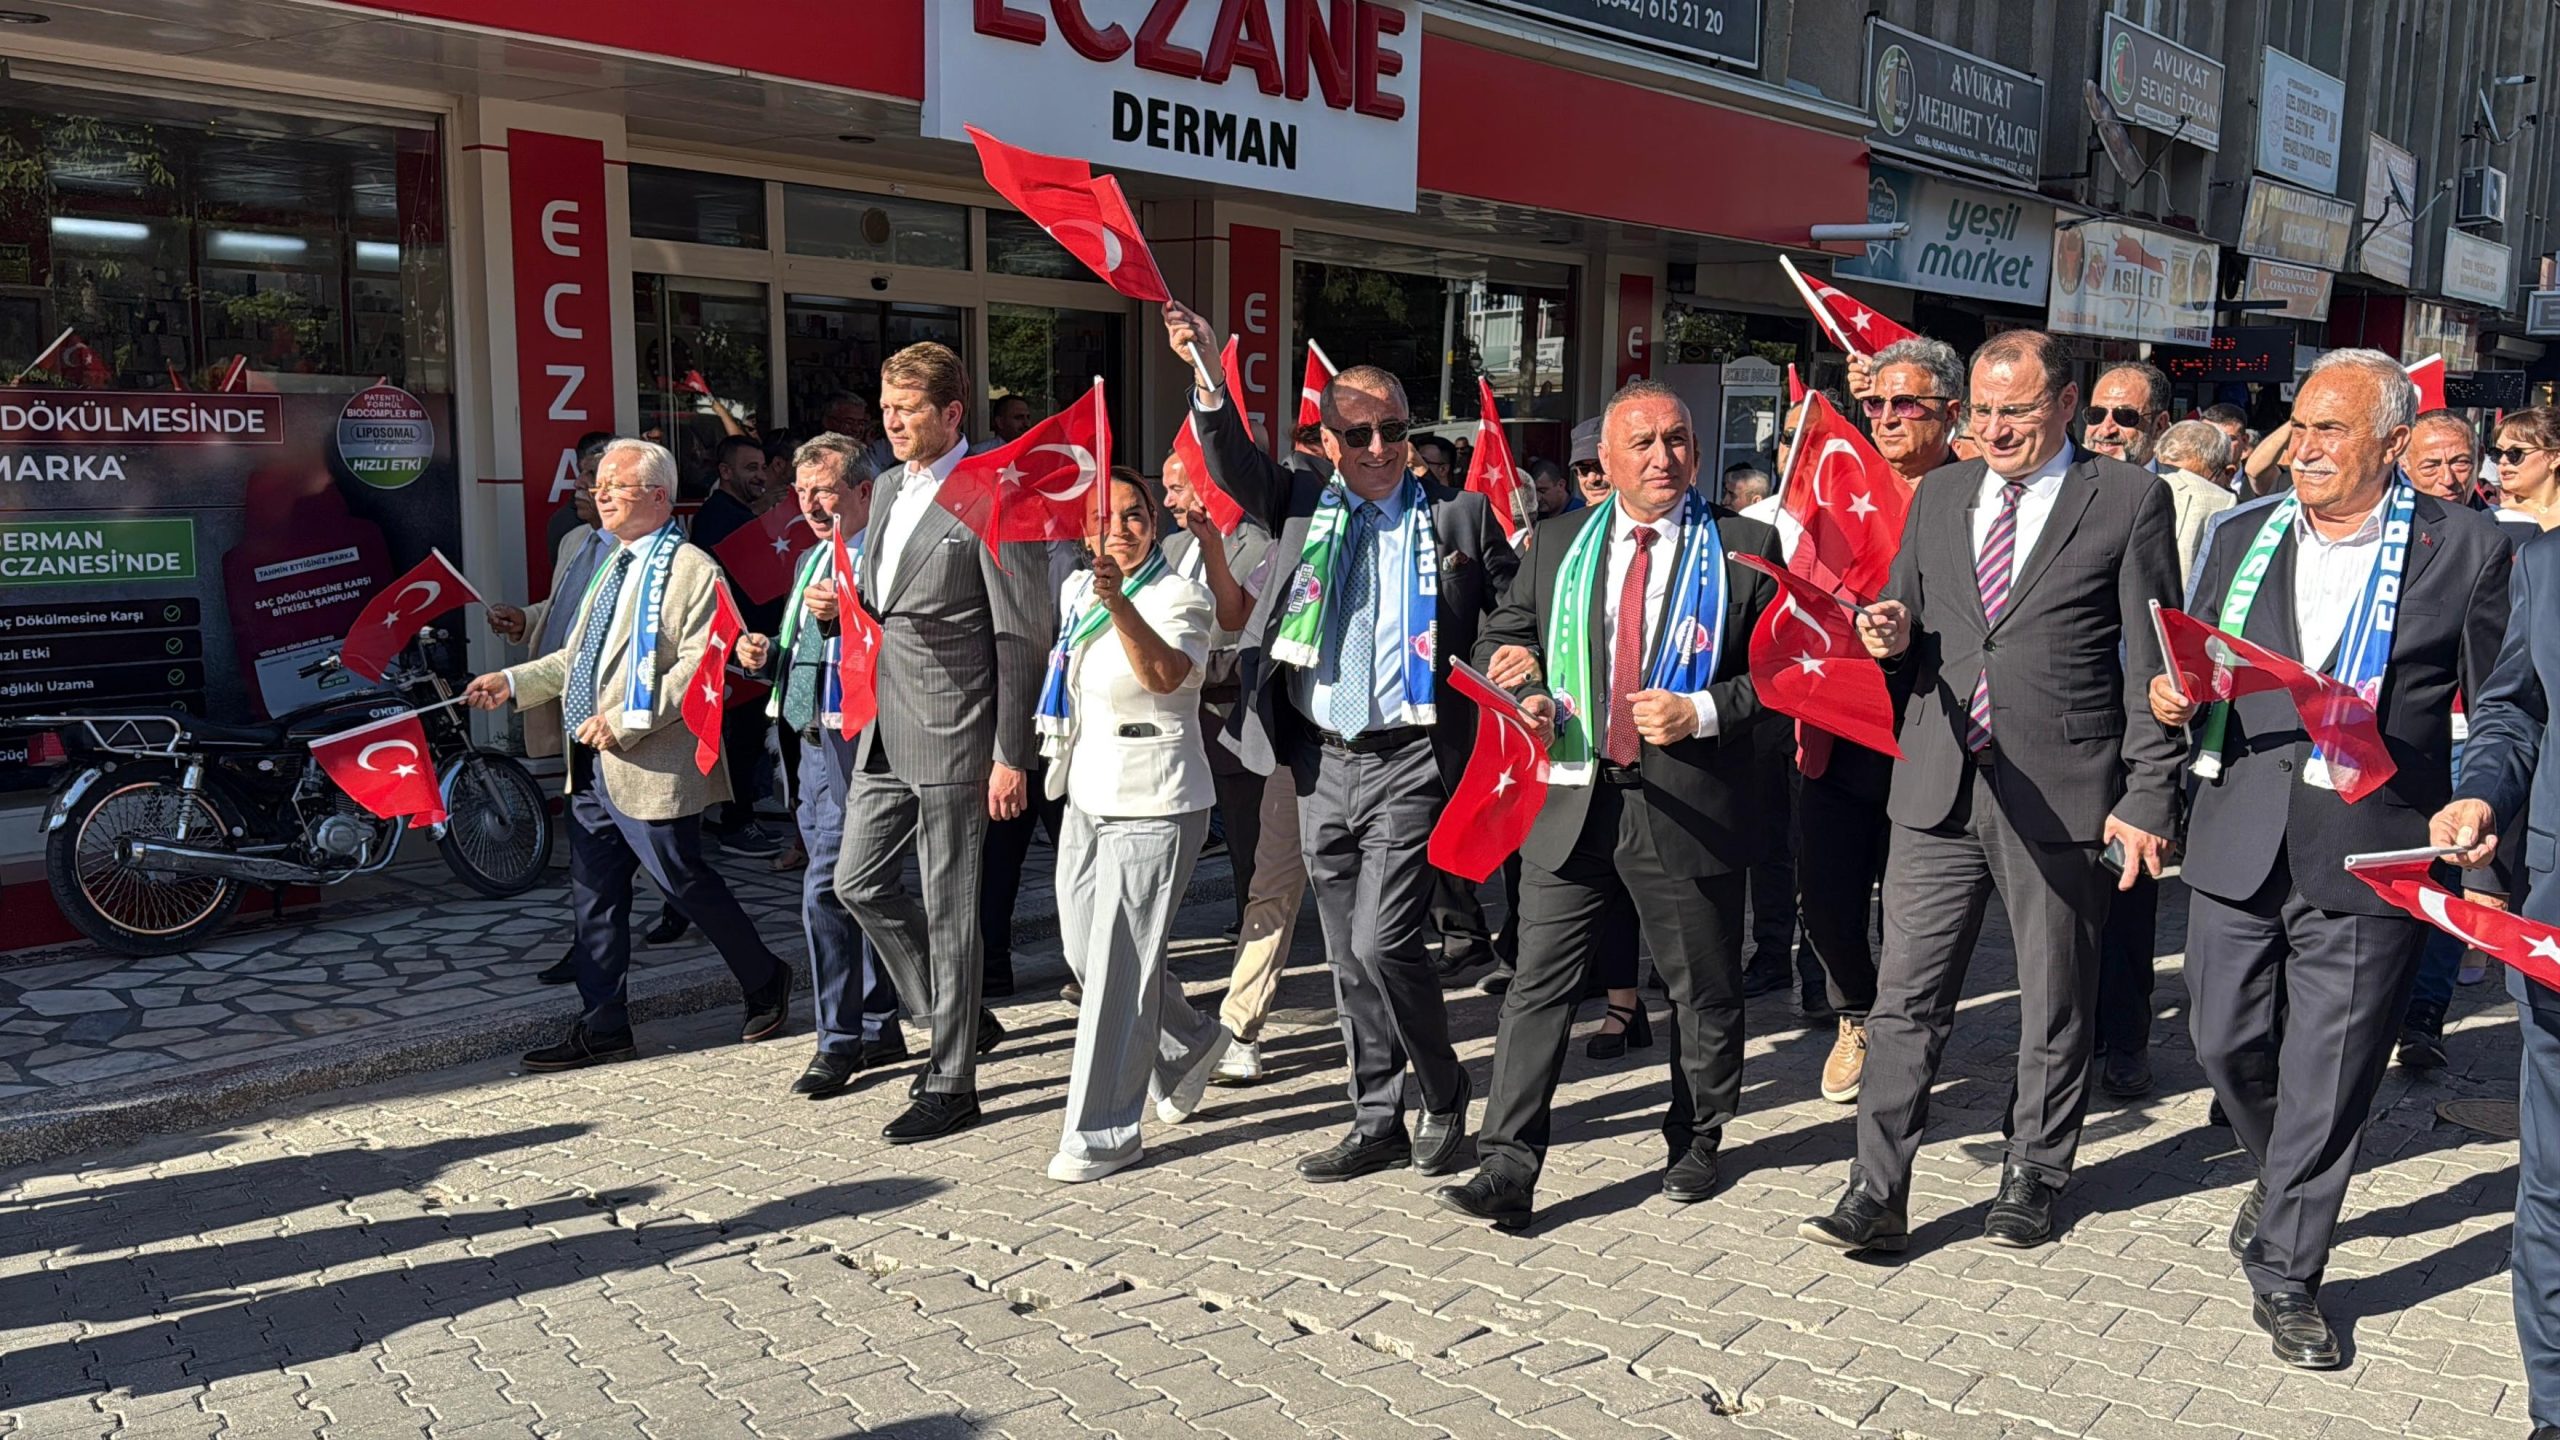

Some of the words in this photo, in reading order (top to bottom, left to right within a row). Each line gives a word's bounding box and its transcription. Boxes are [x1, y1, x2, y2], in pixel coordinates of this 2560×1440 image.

[1649, 0, 1678, 23] 615
[1682, 1, 1699, 29] 21
[1705, 8, 1723, 35] 20
[2153, 49, 2210, 90] AVUKAT
[1950, 64, 2014, 110] AVUKAT
[2140, 76, 2177, 108] SEVGİ
[2180, 86, 2217, 124] ÖZKAN
[1112, 89, 1297, 170] DERMAN
[1916, 93, 1983, 140] MEHMET
[1986, 113, 2038, 159] YALÇIN
[1946, 198, 2022, 245] yeşil
[1917, 242, 2033, 289] market
[2271, 266, 2317, 282] OSMANLI
[2112, 267, 2143, 295] ASİL
[2150, 275, 2164, 298] ET
[2263, 280, 2319, 297] LOKANTASI
[1, 399, 266, 433] DÖKÜLMESİNDE
[356, 427, 416, 439] LIPOSOMAL
[353, 459, 388, 471] HIZLI
[391, 457, 422, 471] ETKİ
[0, 530, 103, 553] ERMAN
[259, 565, 288, 578] TAHMİN
[328, 551, 355, 563] MARKA
[2376, 520, 2409, 631] EBER
[255, 597, 275, 610] SAÇ
[277, 582, 342, 605] DÖKÜLMESİNE
[344, 576, 371, 590] KARŞI
[272, 601, 314, 617] BİTKİSEL
[315, 589, 360, 608] ŞAMPUAN
[16, 612, 108, 628] Dökülmesine
[110, 610, 143, 624] Karşı
[23, 647, 50, 660] Etki
[47, 679, 94, 692] Uzama
[0, 748, 28, 762] Güçl
